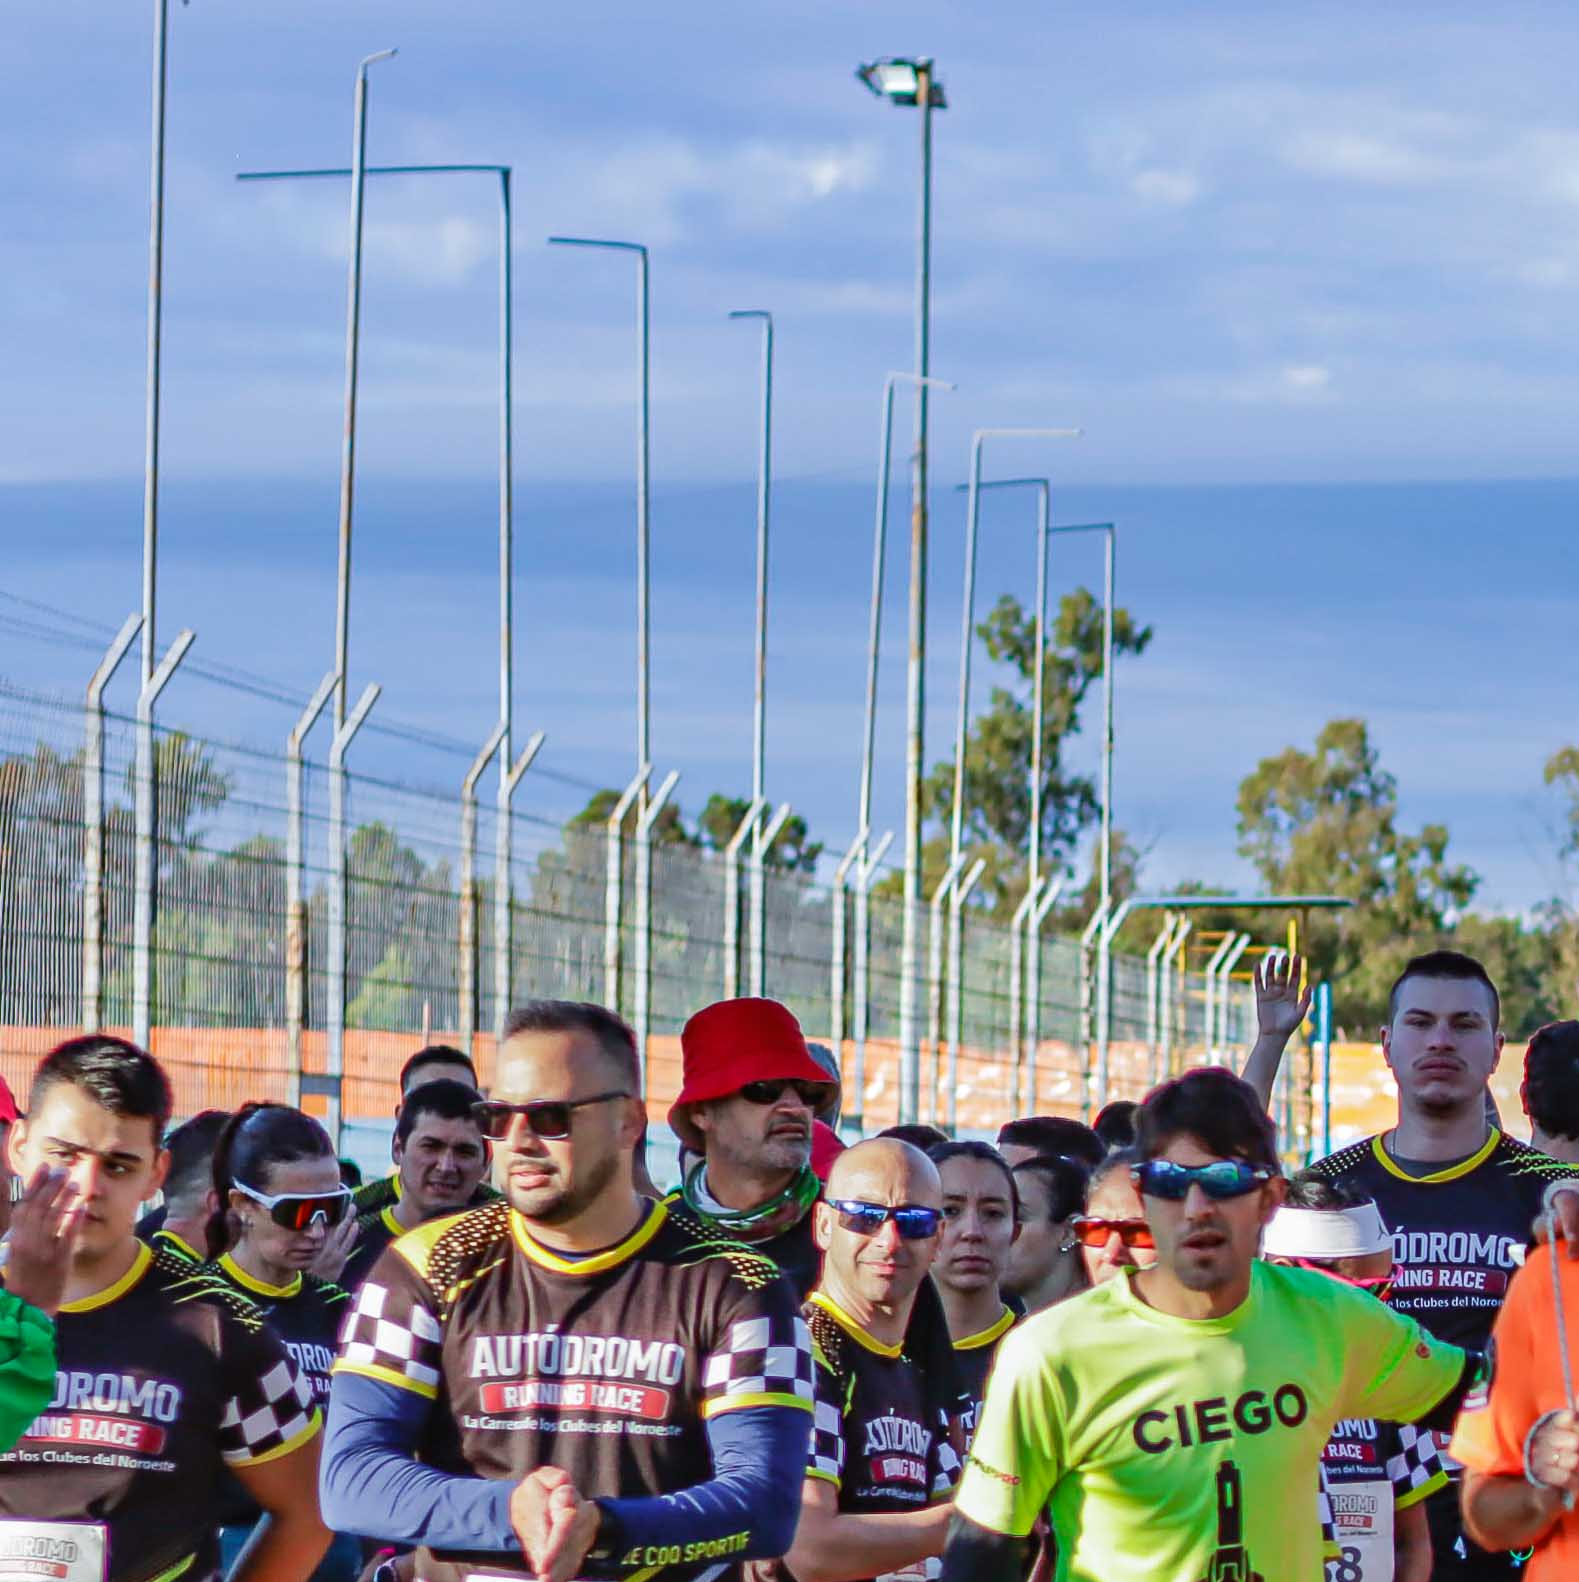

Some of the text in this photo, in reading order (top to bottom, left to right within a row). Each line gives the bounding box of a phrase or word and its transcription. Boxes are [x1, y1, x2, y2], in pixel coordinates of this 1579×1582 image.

[1439, 1269, 1486, 1290] RACE
[1396, 1298, 1411, 1309] los
[1413, 1297, 1449, 1309] Clubes
[1452, 1295, 1469, 1308] del
[469, 1324, 685, 1386] AUTÓDROMO
[591, 1385, 644, 1412] RACE
[78, 1418, 142, 1447] RACE
[1133, 1383, 1308, 1455] CIEGO
[19, 1450, 39, 1462] los
[42, 1451, 90, 1464] Clubes
[93, 1453, 116, 1466] del
[117, 1455, 176, 1471] Noroeste
[1328, 1443, 1363, 1460] RACE
[684, 1530, 750, 1562] SPORTIF
